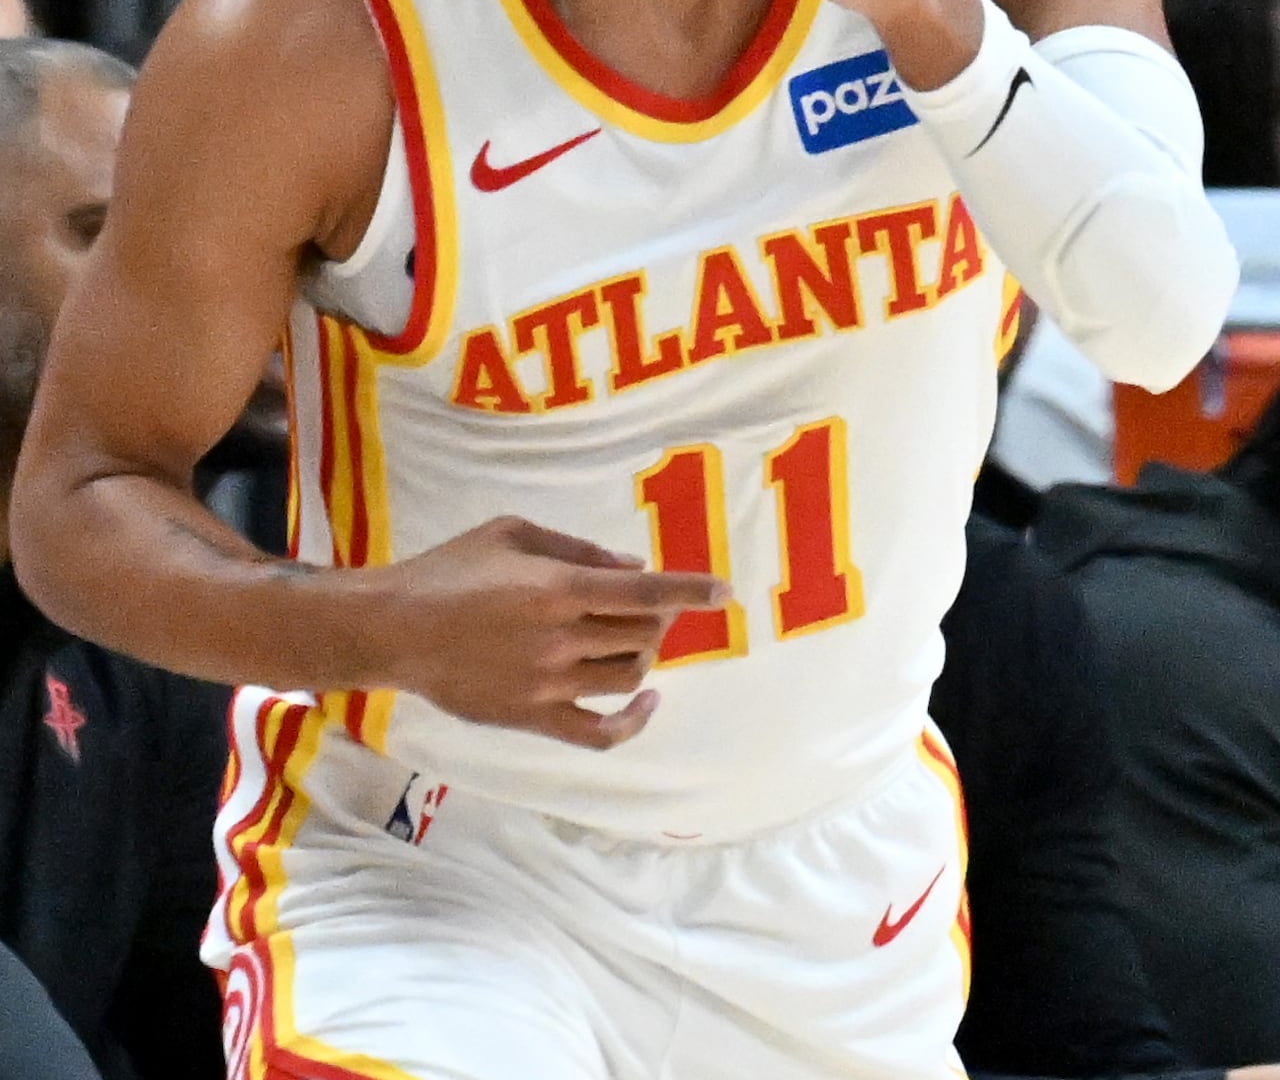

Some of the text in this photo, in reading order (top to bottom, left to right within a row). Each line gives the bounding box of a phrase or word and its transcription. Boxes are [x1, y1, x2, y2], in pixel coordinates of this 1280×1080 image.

[800, 69, 904, 136] paz
[448, 190, 987, 416] ATLANTA
[632, 415, 865, 670] 11
